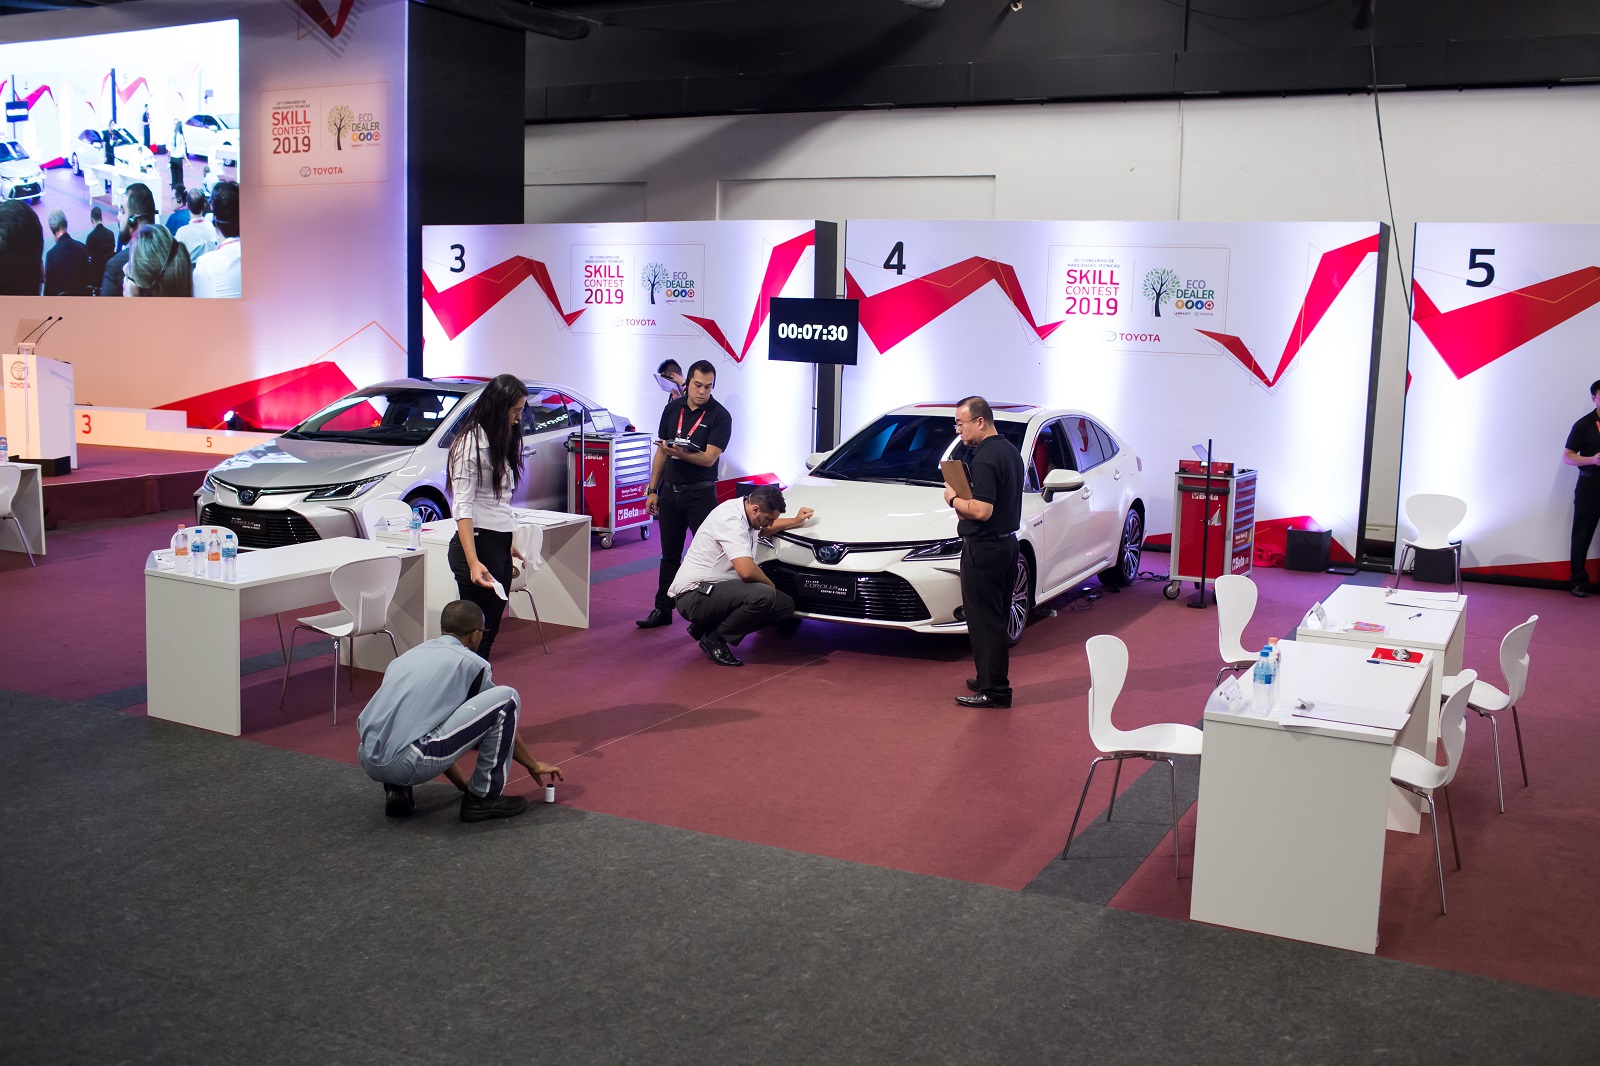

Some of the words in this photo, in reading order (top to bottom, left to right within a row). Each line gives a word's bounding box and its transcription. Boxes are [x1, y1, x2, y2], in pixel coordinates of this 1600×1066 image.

[272, 110, 311, 126] SKILL
[359, 113, 374, 122] ECO
[272, 125, 311, 136] CONTEST
[351, 121, 380, 132] DEALER
[272, 135, 311, 154] 2019
[313, 167, 343, 175] TOYOTA
[449, 243, 466, 273] 3
[883, 241, 907, 275] 4
[584, 265, 624, 279] SKILL
[1465, 248, 1496, 288] 5
[673, 271, 688, 280] ECO
[1066, 269, 1120, 286] SKILL
[584, 279, 624, 288] CONTEST
[666, 280, 695, 289] DEALER
[1185, 279, 1206, 289] ECO
[584, 289, 624, 304] 2019
[1065, 286, 1120, 296] CONTEST
[1176, 289, 1215, 300] DEALER
[1065, 297, 1119, 316] 2019
[625, 319, 656, 327] TOYOTA
[778, 323, 848, 341] 00:07:30
[1119, 333, 1161, 342] TOYOTA
[82, 414, 92, 434] 3
[206, 437, 213, 448] 5
[624, 507, 639, 519] Beta
